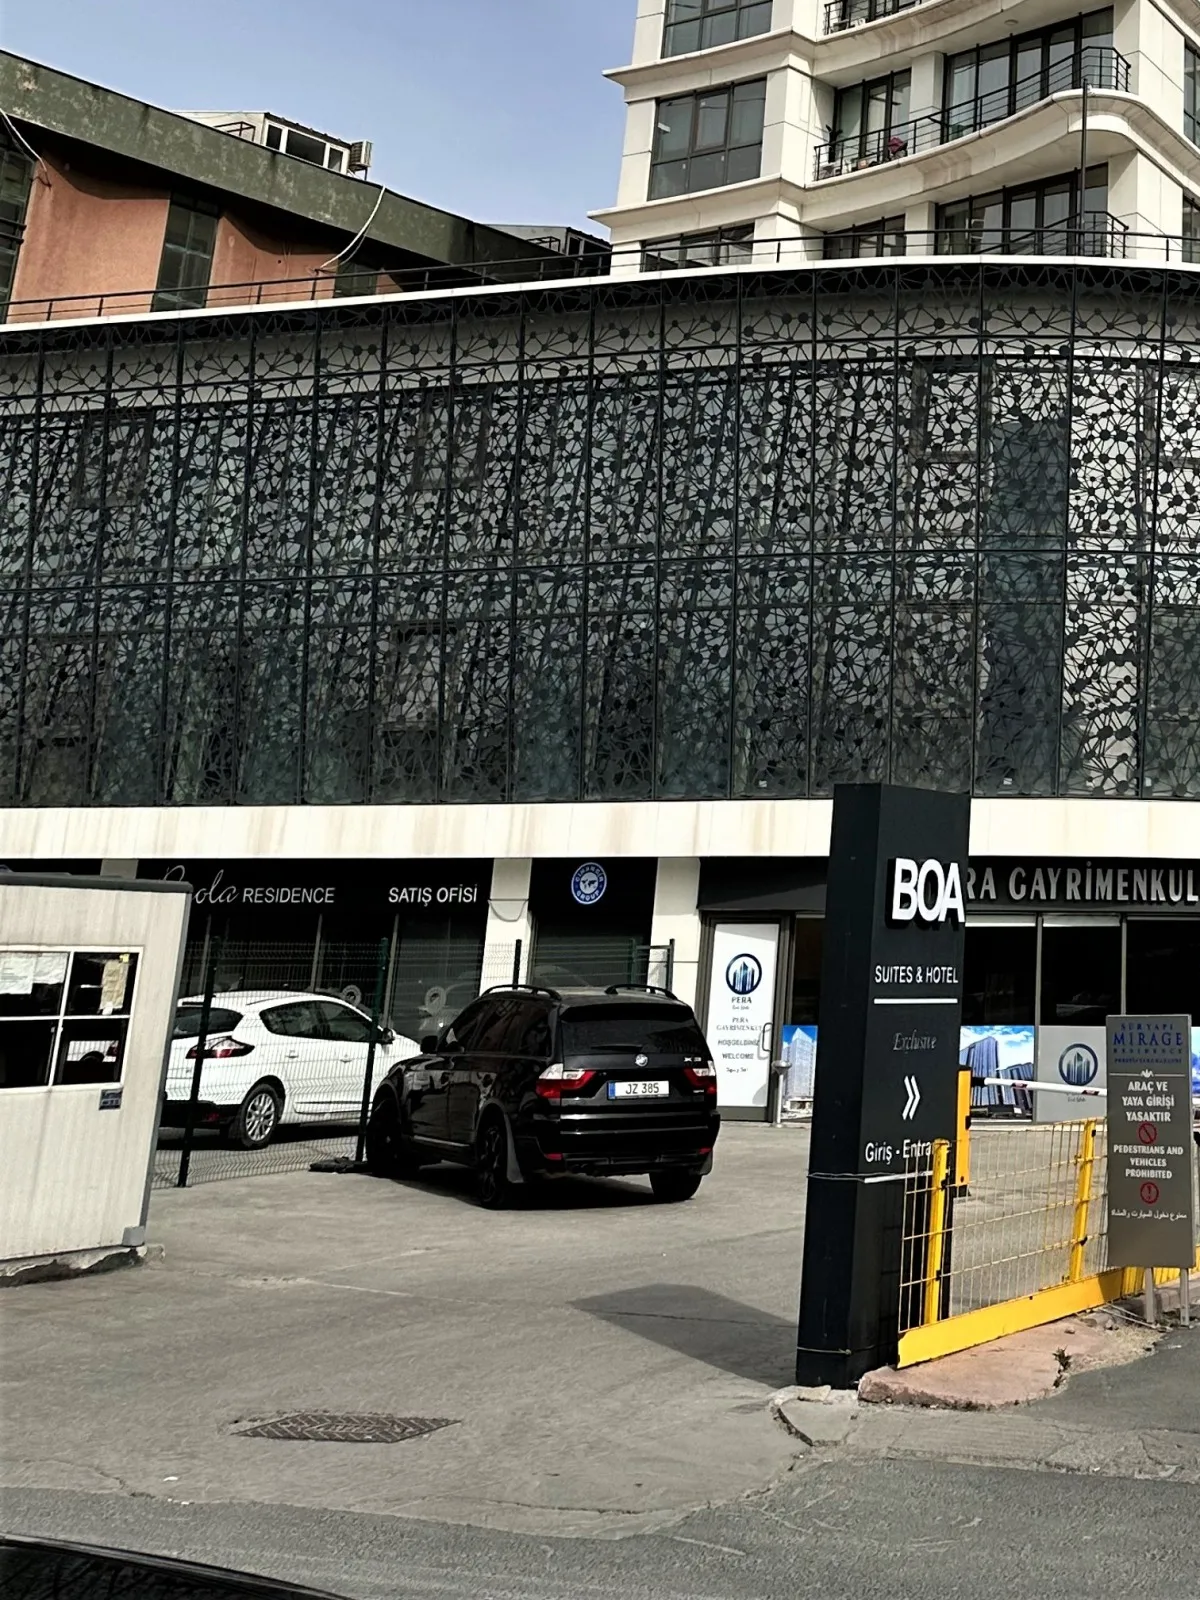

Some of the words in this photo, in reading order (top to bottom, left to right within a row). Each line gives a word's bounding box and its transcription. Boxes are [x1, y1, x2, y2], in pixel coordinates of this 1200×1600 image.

[965, 867, 997, 900] RA
[1008, 861, 1199, 902] GAYRİMENKUL
[242, 887, 335, 903] RESIDENCE
[388, 886, 432, 907] SATIŞ
[436, 883, 478, 903] OFİSİ
[892, 857, 966, 923] BOA
[874, 965, 913, 984] SUITES
[915, 966, 923, 983] &
[925, 966, 959, 984] HOTEL
[625, 1083, 639, 1095] JZ
[641, 1082, 660, 1094] 385
[1128, 1081, 1154, 1094] ARAÇ
[1156, 1081, 1168, 1091] VE
[1122, 1096, 1143, 1106] YAYA
[1146, 1094, 1175, 1109] GİRİŞİ
[1125, 1111, 1171, 1122] YASAKTIR
[865, 1142, 893, 1165] Giriş
[1113, 1144, 1165, 1155] PEDESTRIANS
[1166, 1146, 1184, 1155] AND
[1129, 1157, 1167, 1167] VEHICLES
[1125, 1168, 1172, 1179] PROHIBITED
